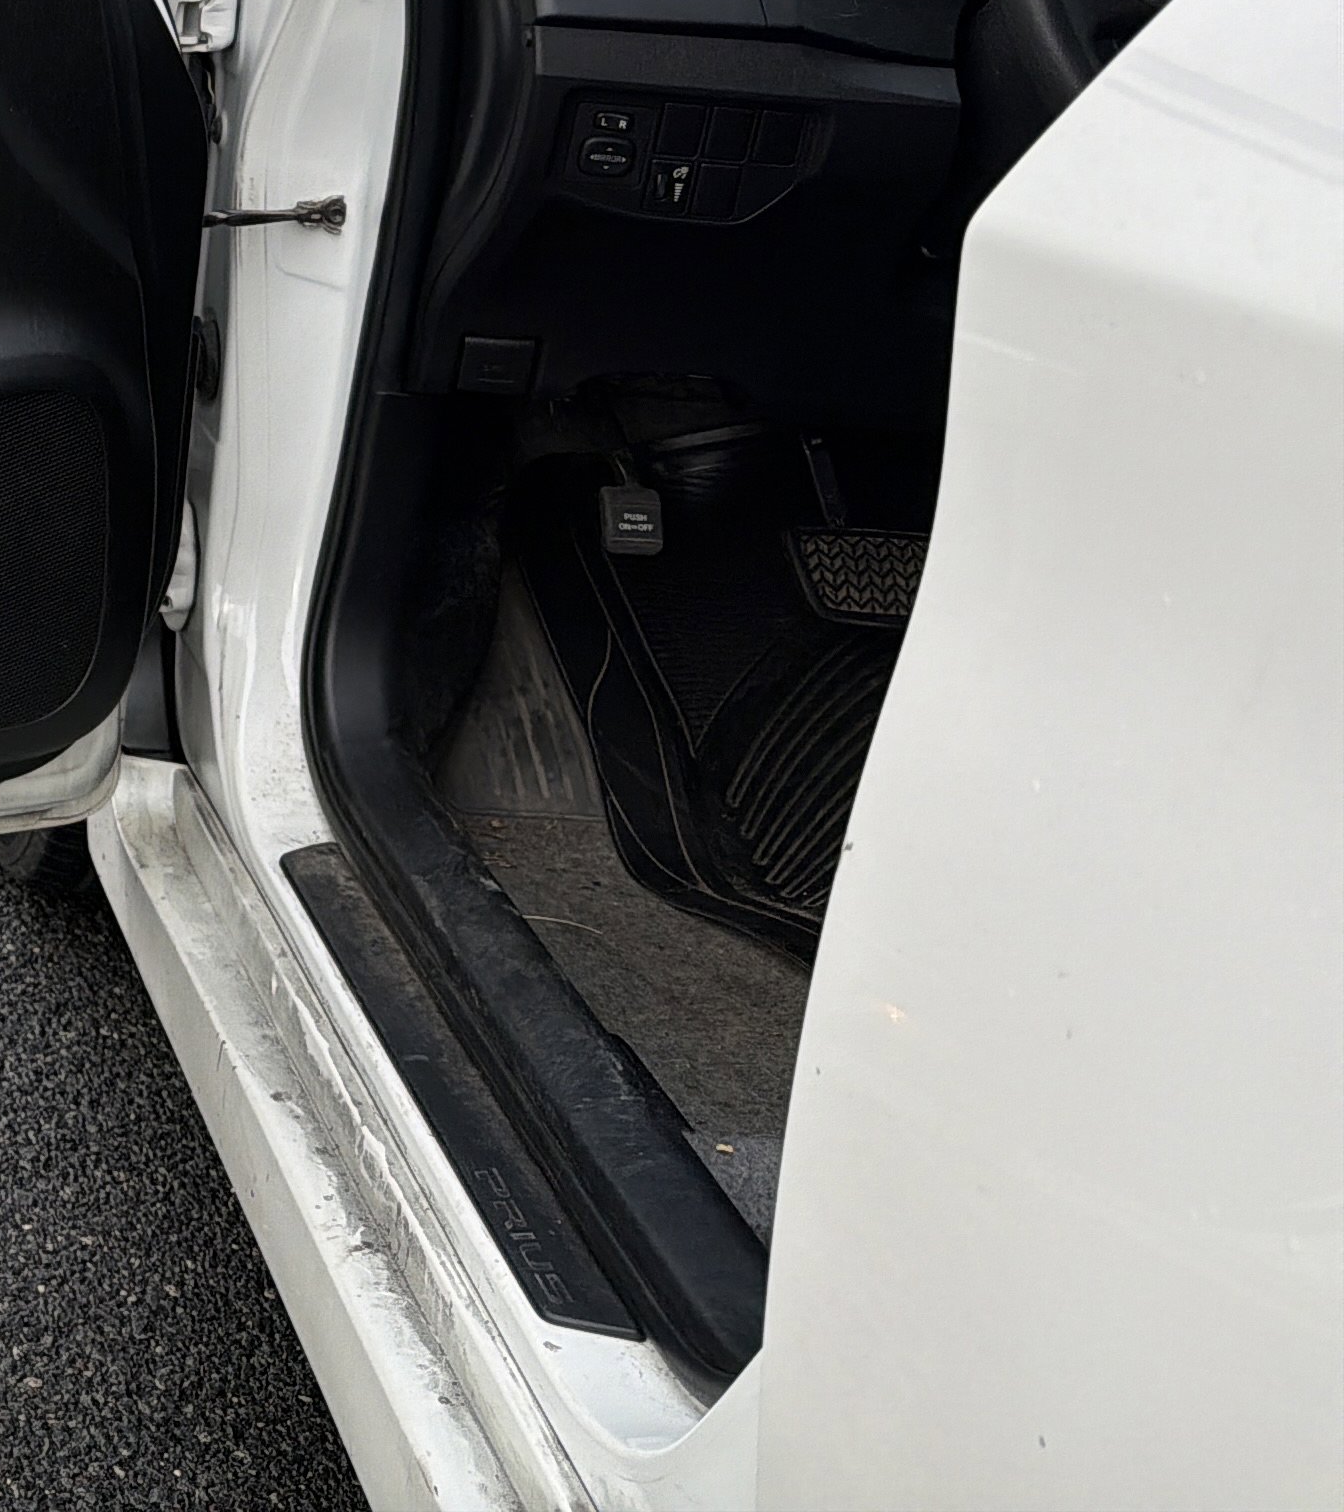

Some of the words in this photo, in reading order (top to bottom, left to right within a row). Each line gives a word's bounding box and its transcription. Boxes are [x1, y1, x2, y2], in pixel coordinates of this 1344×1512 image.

[600, 117, 609, 127] L
[618, 119, 628, 130] R
[623, 512, 648, 522] PUSH
[474, 1167, 575, 1304] PRIUS
